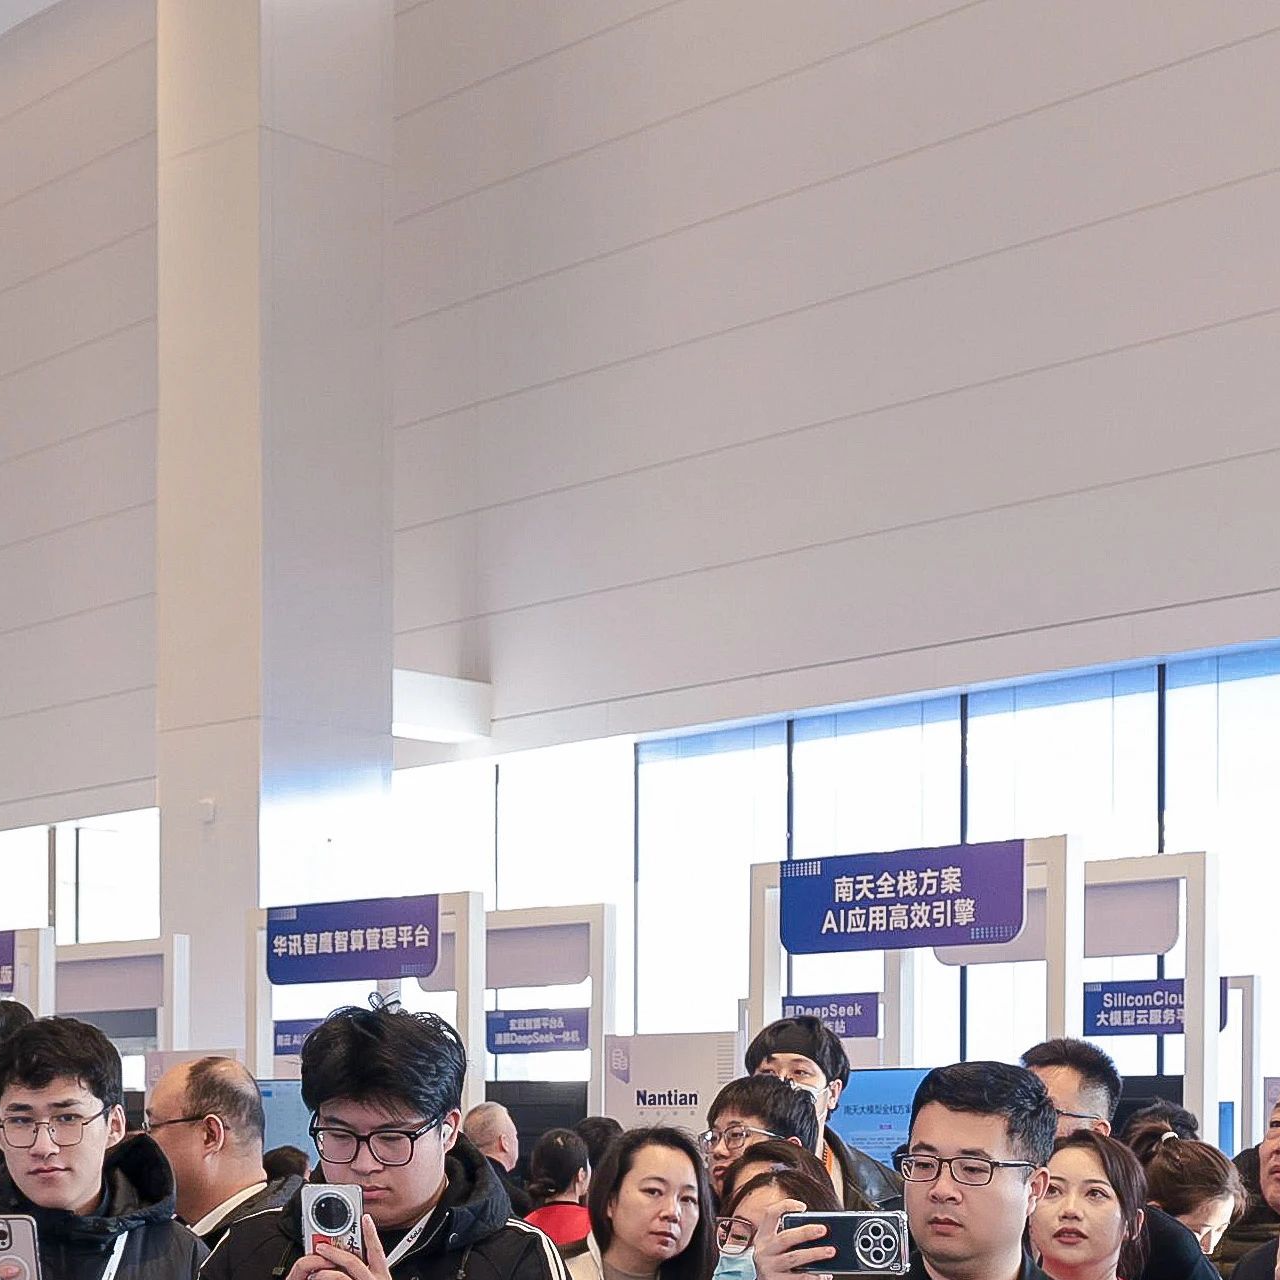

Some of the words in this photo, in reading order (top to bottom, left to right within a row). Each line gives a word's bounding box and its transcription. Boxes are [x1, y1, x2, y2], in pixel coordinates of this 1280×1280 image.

[833, 866, 962, 903] 南天全栈方案
[821, 897, 976, 935] AI应用高效引擎
[636, 1089, 698, 1106] Nantian
